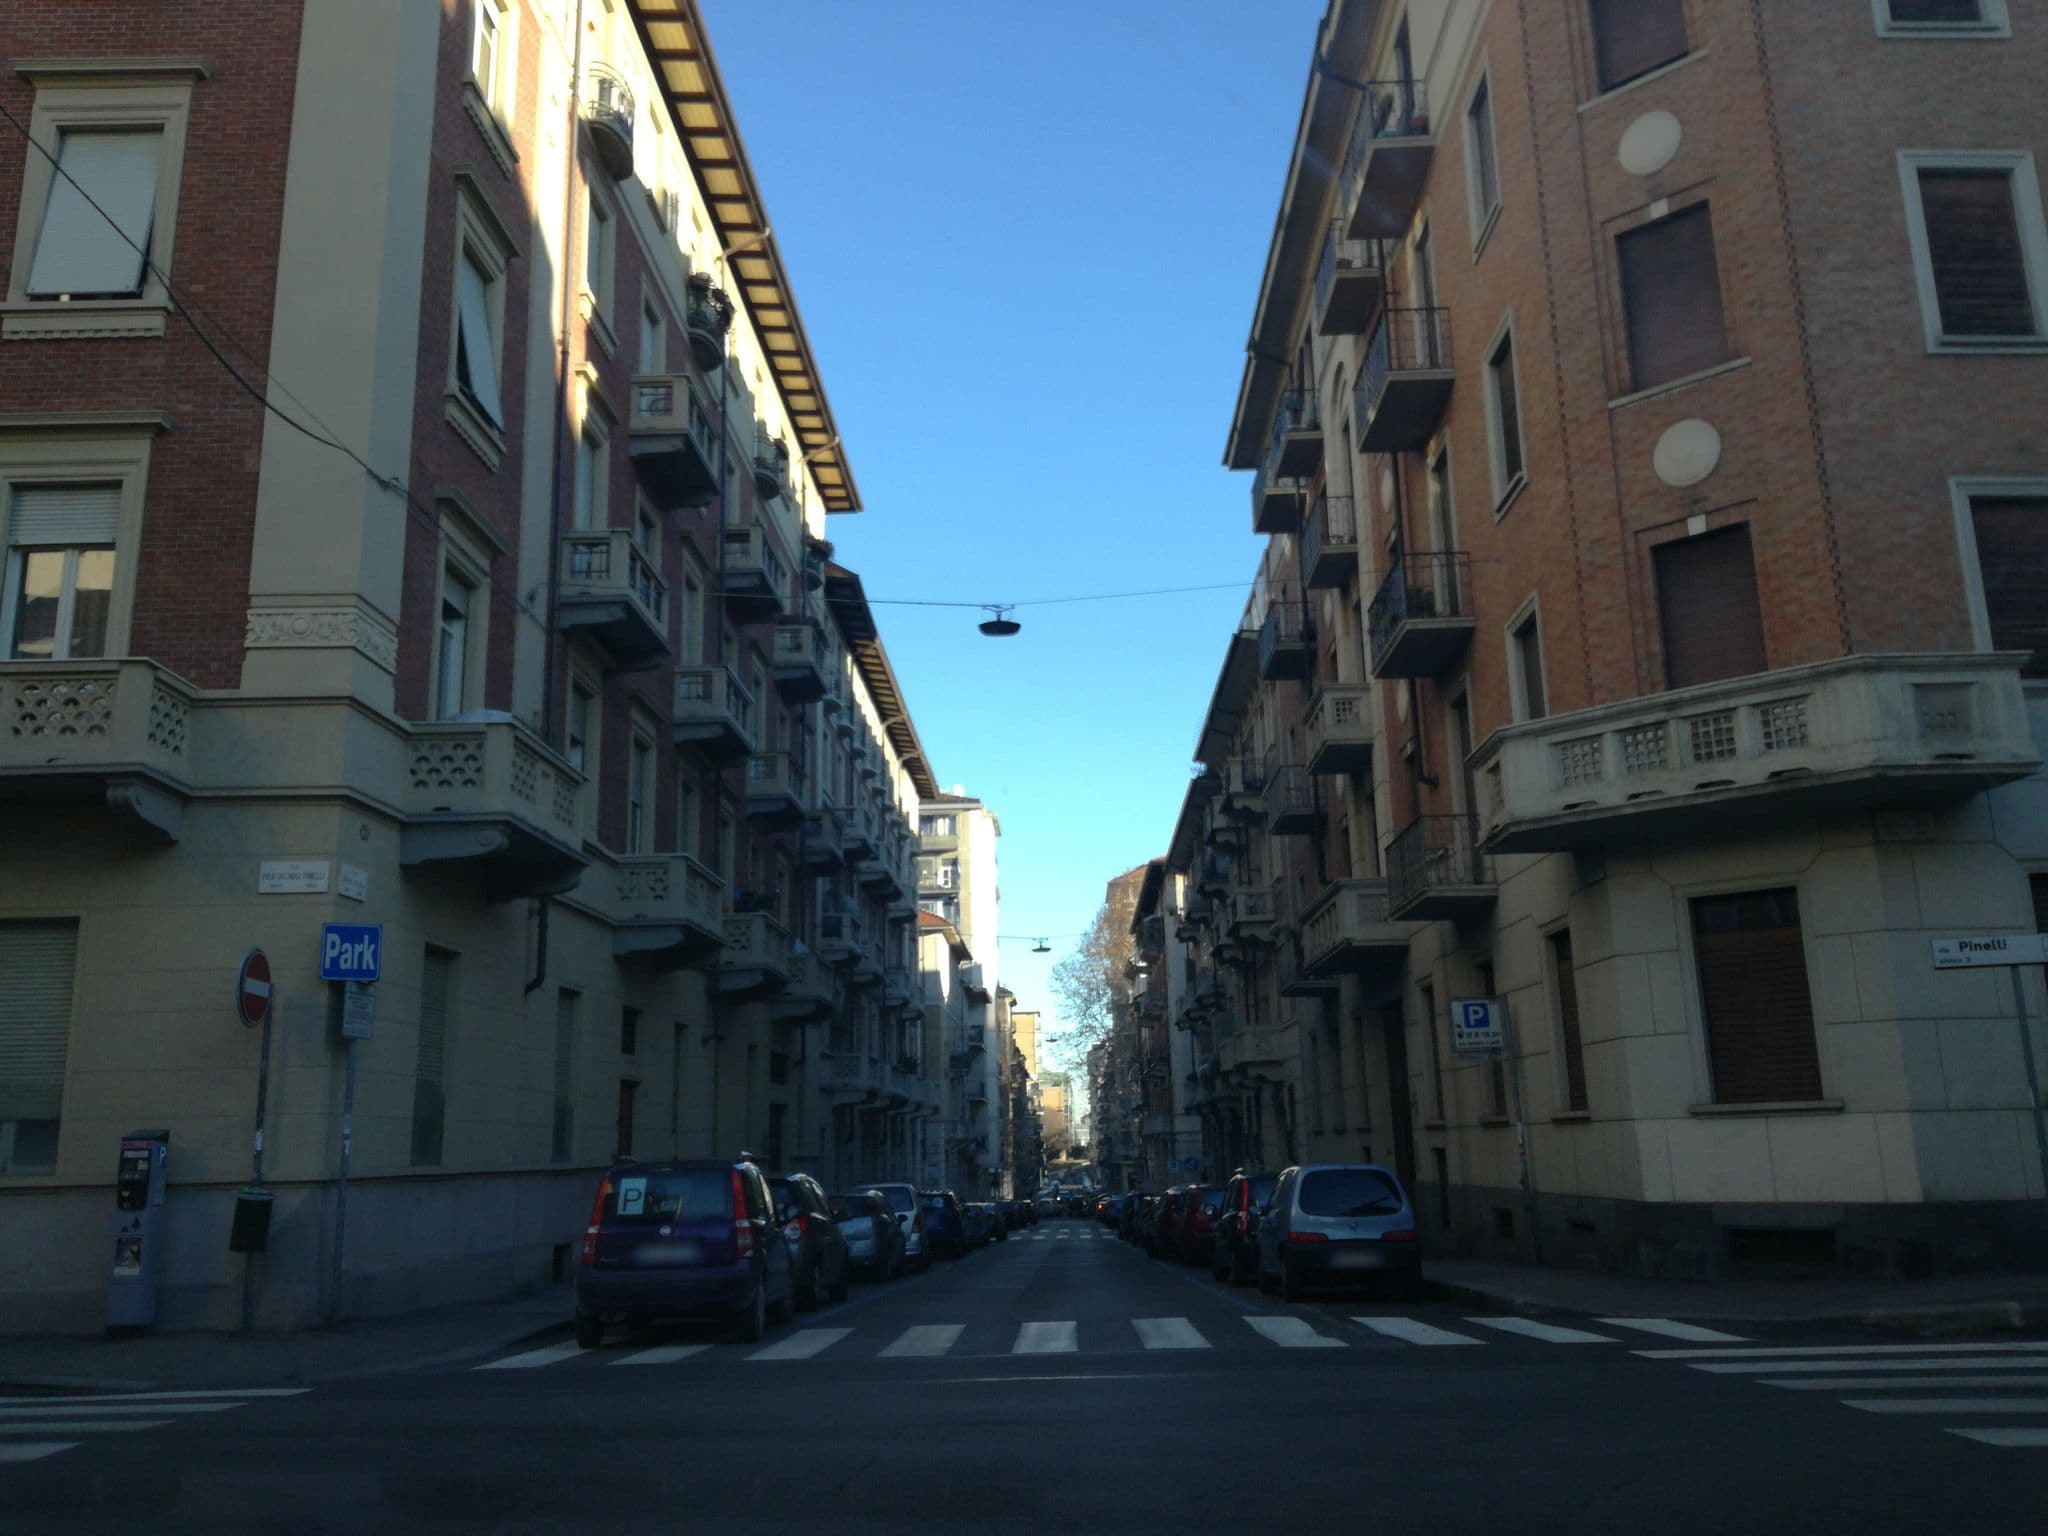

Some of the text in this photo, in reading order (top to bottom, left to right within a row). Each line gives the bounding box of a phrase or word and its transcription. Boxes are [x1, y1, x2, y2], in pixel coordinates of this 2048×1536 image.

[324, 933, 376, 970] Park
[1958, 938, 2007, 952] Pinelli
[1468, 1005, 1484, 1026] P
[623, 1188, 642, 1212] P
